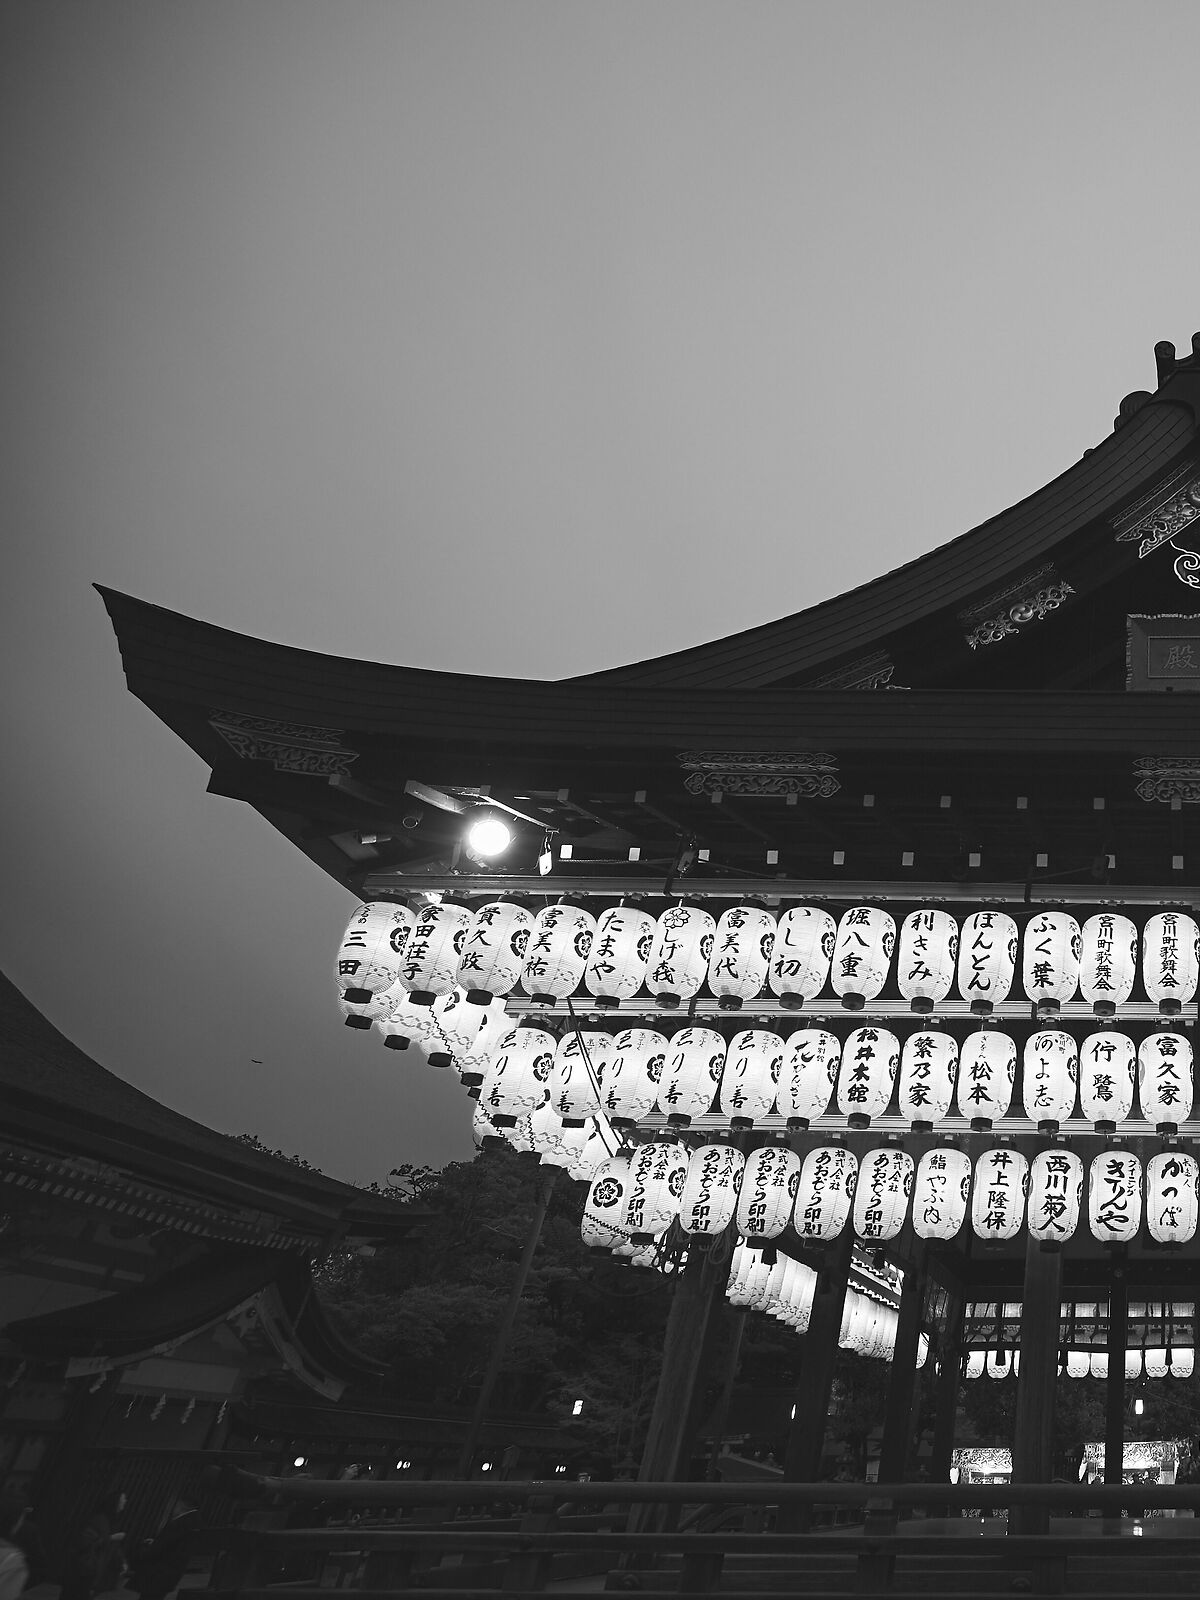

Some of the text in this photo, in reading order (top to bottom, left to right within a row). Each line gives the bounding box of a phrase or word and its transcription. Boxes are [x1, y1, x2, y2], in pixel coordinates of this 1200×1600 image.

[338, 930, 368, 976] 三田
[402, 906, 445, 981] 家田荘子
[589, 911, 625, 982] たまや
[714, 909, 750, 979] 富美代
[840, 909, 874, 978] 堀八重
[908, 912, 933, 981] 利きみ
[1030, 916, 1057, 989] ふく葉
[1091, 915, 1116, 992] 宮川町歌舞会
[1157, 914, 1181, 988] 宮川町歌舞会
[847, 1028, 880, 1103] 松井本館
[908, 1036, 938, 1108] 繁乃家
[966, 1060, 994, 1106] 松本
[1155, 1036, 1182, 1106] 富久家
[624, 1144, 657, 1228] あおぞら印刷
[687, 1148, 721, 1232] あおぞら印刷
[744, 1148, 776, 1233] あおぞら印刷
[801, 1150, 832, 1236] あおぞら印刷
[861, 1152, 891, 1238] あおぞら印刷
[981, 1151, 1014, 1231] 井上隆保
